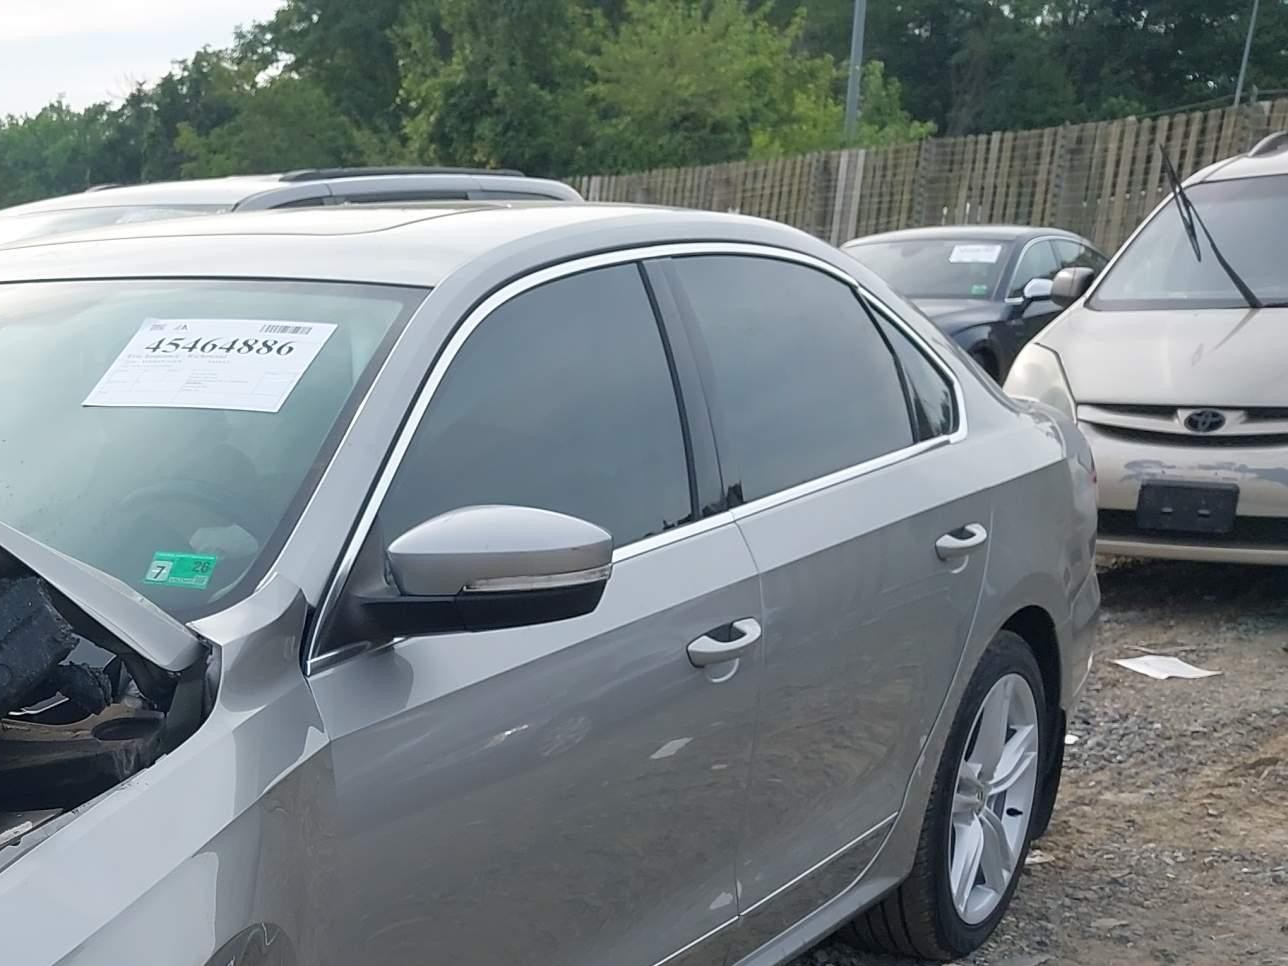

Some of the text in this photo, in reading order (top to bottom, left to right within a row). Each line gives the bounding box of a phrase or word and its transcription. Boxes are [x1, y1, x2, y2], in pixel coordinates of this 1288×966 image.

[145, 337, 295, 356] 45464886
[153, 565, 166, 579] 7
[192, 561, 210, 573] 26
